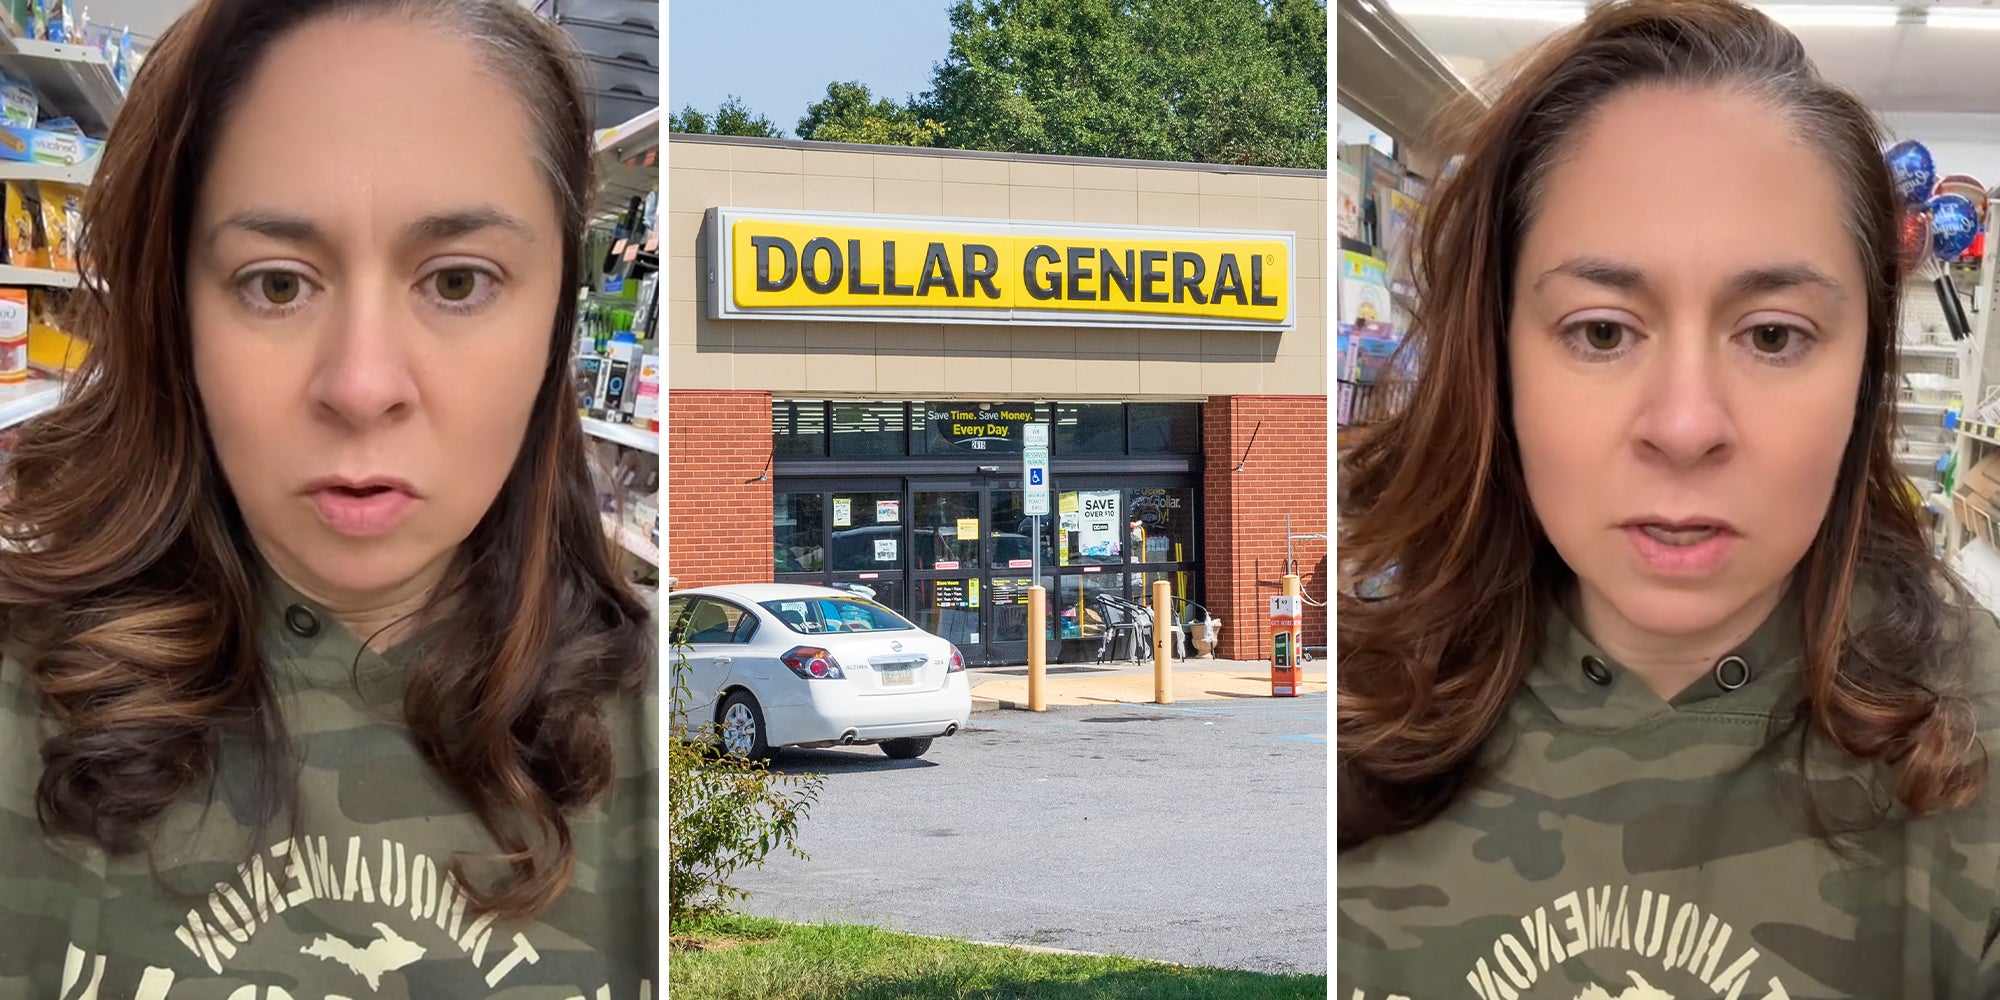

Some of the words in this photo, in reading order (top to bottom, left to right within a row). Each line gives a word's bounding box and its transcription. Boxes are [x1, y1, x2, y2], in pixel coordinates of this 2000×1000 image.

[750, 234, 1001, 299] DOLLAR
[1023, 244, 1278, 307] GENERAL
[928, 411, 949, 420] Save
[951, 410, 977, 420] Time.
[979, 411, 999, 420] Save
[1000, 411, 1033, 422] Money.
[953, 424, 984, 437] Every
[987, 424, 1010, 437] Day.
[1085, 499, 1115, 510] SAVE
